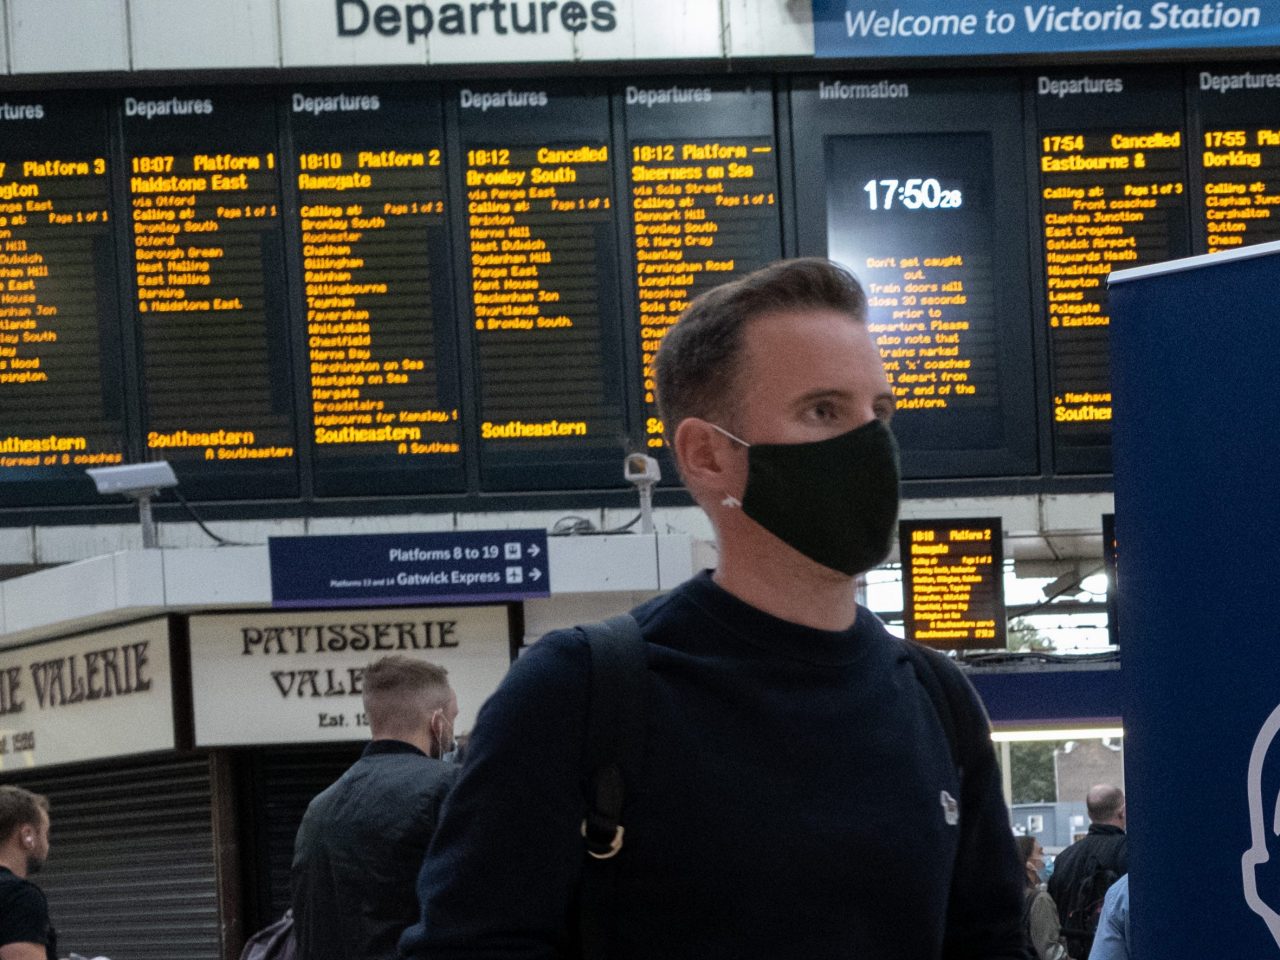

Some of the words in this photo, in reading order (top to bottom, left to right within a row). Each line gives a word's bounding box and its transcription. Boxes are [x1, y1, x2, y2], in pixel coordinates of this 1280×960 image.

[336, 0, 617, 45] Departures
[846, 10, 977, 36] Welcome
[986, 10, 1015, 34] to
[1025, 5, 1142, 32] Victoria
[1149, 2, 1260, 29] Station
[819, 82, 908, 103] Information
[1039, 77, 1123, 97] Departures
[293, 94, 379, 115] Departures
[461, 90, 548, 111] Departures
[625, 86, 712, 108] Departures
[126, 98, 212, 118] Departures
[1043, 136, 1085, 151] 17:54
[1110, 133, 1181, 149] Cancelled
[1204, 131, 1246, 147] 17:55
[299, 154, 342, 169] 18:10
[357, 154, 432, 167] Platform
[428, 149, 441, 165] 2
[467, 150, 510, 165] 18:12
[536, 147, 608, 163] Cancelled
[633, 146, 675, 161] 18:12
[681, 145, 748, 159] Platform
[1202, 151, 1262, 167] Dorking
[23, 162, 90, 176] Platform
[93, 159, 106, 174] 3
[132, 157, 175, 172] 18:07
[193, 155, 260, 170] Platform
[266, 153, 275, 168] 1
[1041, 156, 1130, 171] Eastbourne
[466, 170, 526, 185] Bromley
[530, 168, 577, 183] South
[631, 166, 703, 181] Sheerness
[706, 166, 725, 178] on
[728, 163, 754, 178] Sea
[130, 177, 207, 192] Maidstone
[210, 174, 248, 190] East
[298, 174, 372, 189] Ramsgate
[183, 221, 219, 231] South
[137, 275, 164, 286] East
[315, 424, 422, 445] Southeastern
[481, 422, 587, 437] Southeastern
[147, 432, 255, 447] Southeastern
[390, 548, 451, 561] Platforms
[453, 547, 462, 559] 8
[465, 548, 479, 559] to
[483, 546, 498, 558] 19
[397, 572, 448, 585] Gatwick
[451, 571, 500, 585] Express
[242, 622, 459, 655] PATISSERIE
[30, 641, 152, 709] VALERIE
[318, 713, 348, 727] Est.
